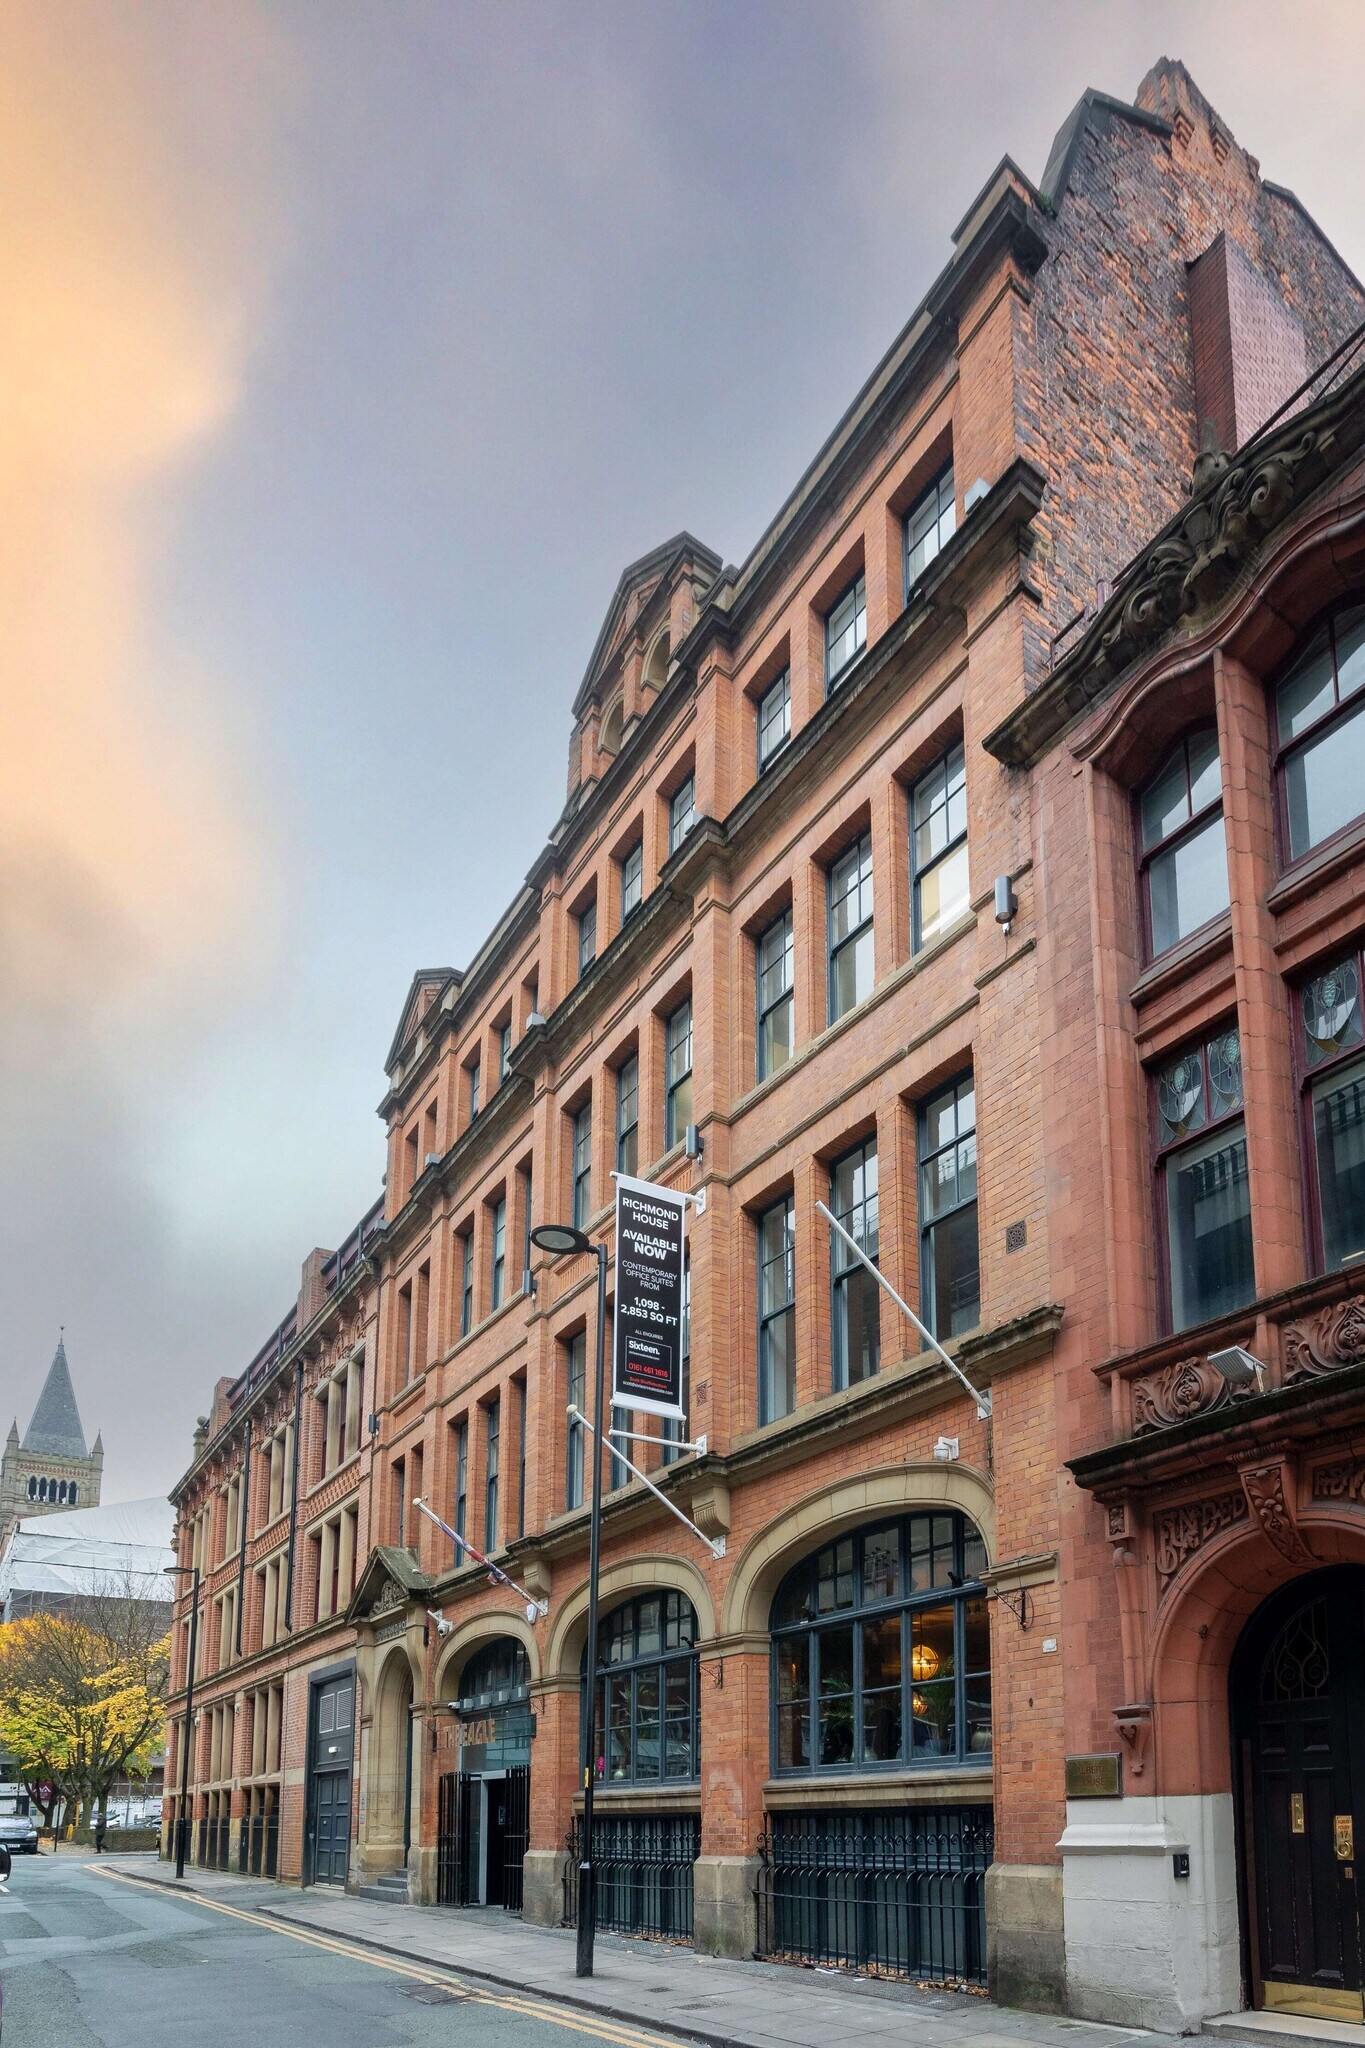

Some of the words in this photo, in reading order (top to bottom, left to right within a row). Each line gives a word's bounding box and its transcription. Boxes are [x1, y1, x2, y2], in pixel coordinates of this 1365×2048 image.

[622, 1197, 679, 1221] RICHMOND
[633, 1211, 669, 1230] HOUSE
[622, 1229, 678, 1252] AVAILABLE
[634, 1242, 667, 1260] NOW
[622, 1260, 677, 1281] CONTEMPORARY
[626, 1269, 650, 1281] OFFICE
[651, 1275, 674, 1288] SUITES
[640, 1281, 660, 1291] FROM
[634, 1297, 659, 1311] 1,098
[621, 1304, 648, 1319] 2,853
[650, 1311, 664, 1323] SQ
[666, 1315, 678, 1326] FT
[628, 1340, 660, 1355] Sixteen.
[628, 1363, 642, 1371] 0161
[643, 1366, 653, 1375] 461
[461, 1718, 496, 1747] EAGLE
[1077, 1765, 1105, 1775] ALBERT
[1340, 1830, 1349, 1839] 17
